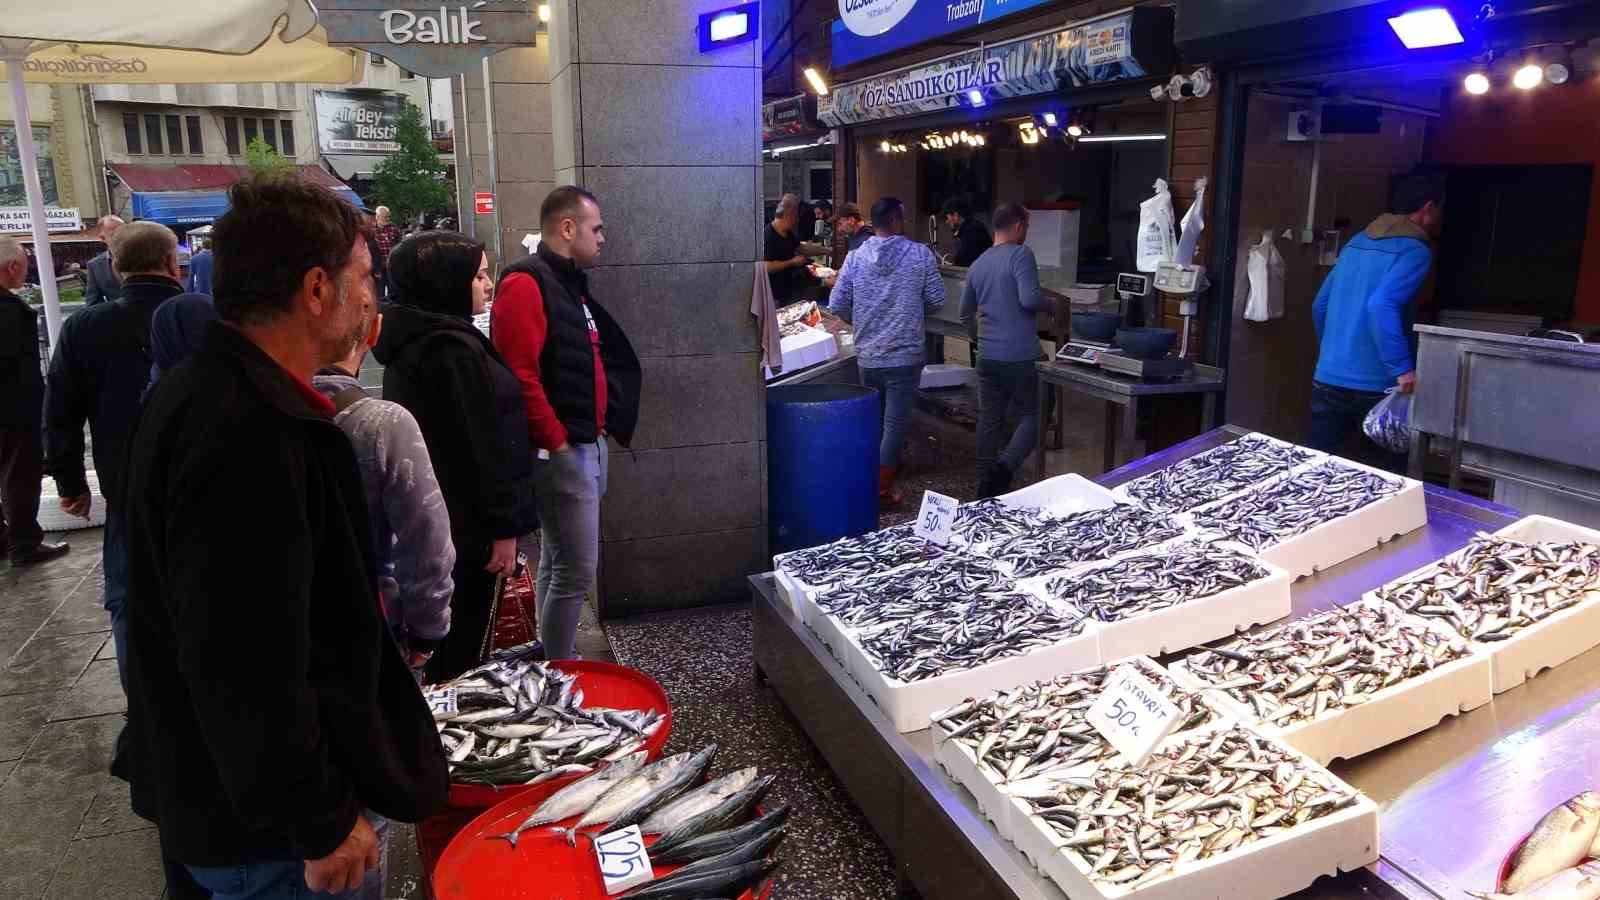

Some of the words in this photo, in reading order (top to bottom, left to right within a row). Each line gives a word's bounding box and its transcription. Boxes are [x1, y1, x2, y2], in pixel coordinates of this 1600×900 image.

[947, 0, 980, 22] Trabzon
[379, 6, 487, 44] Balık
[866, 85, 883, 108] ÖZ
[356, 108, 382, 125] Bey
[924, 511, 939, 531] 50
[1104, 697, 1137, 727] 50
[597, 830, 645, 878] 125
